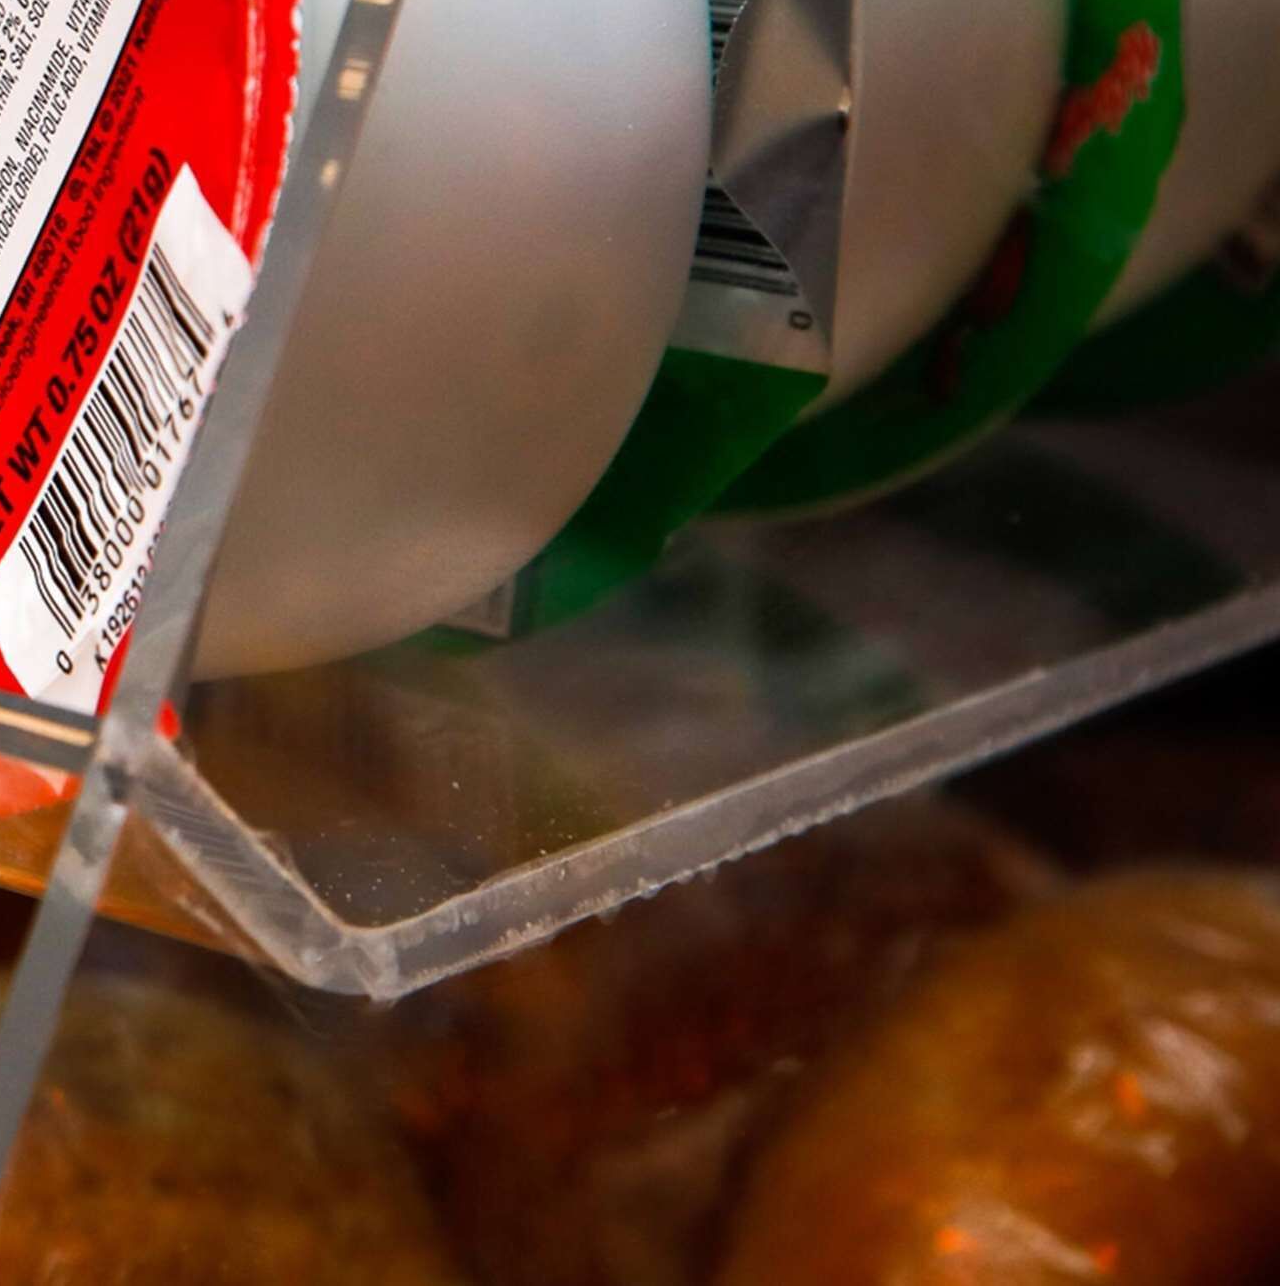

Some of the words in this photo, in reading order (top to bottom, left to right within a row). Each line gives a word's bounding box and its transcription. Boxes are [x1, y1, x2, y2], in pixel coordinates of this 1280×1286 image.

[1, 12, 22, 44] 2%
[9, 24, 38, 71] SALT,
[14, 38, 74, 153] NIACINAMIDE,
[38, 92, 68, 144] FOLIC
[59, 54, 87, 100] ACID,
[64, 193, 99, 255] food
[90, 85, 145, 202] ingredient
[15, 279, 36, 310] MI
[32, 213, 68, 279] 49016
[6, 405, 52, 483] WT
[45, 315, 100, 416] 0.75
[89, 256, 126, 325] OZ
[117, 147, 172, 267] (21g)
[56, 650, 74, 676] 0
[82, 494, 145, 616] 38000
[143, 365, 203, 492] 01767
